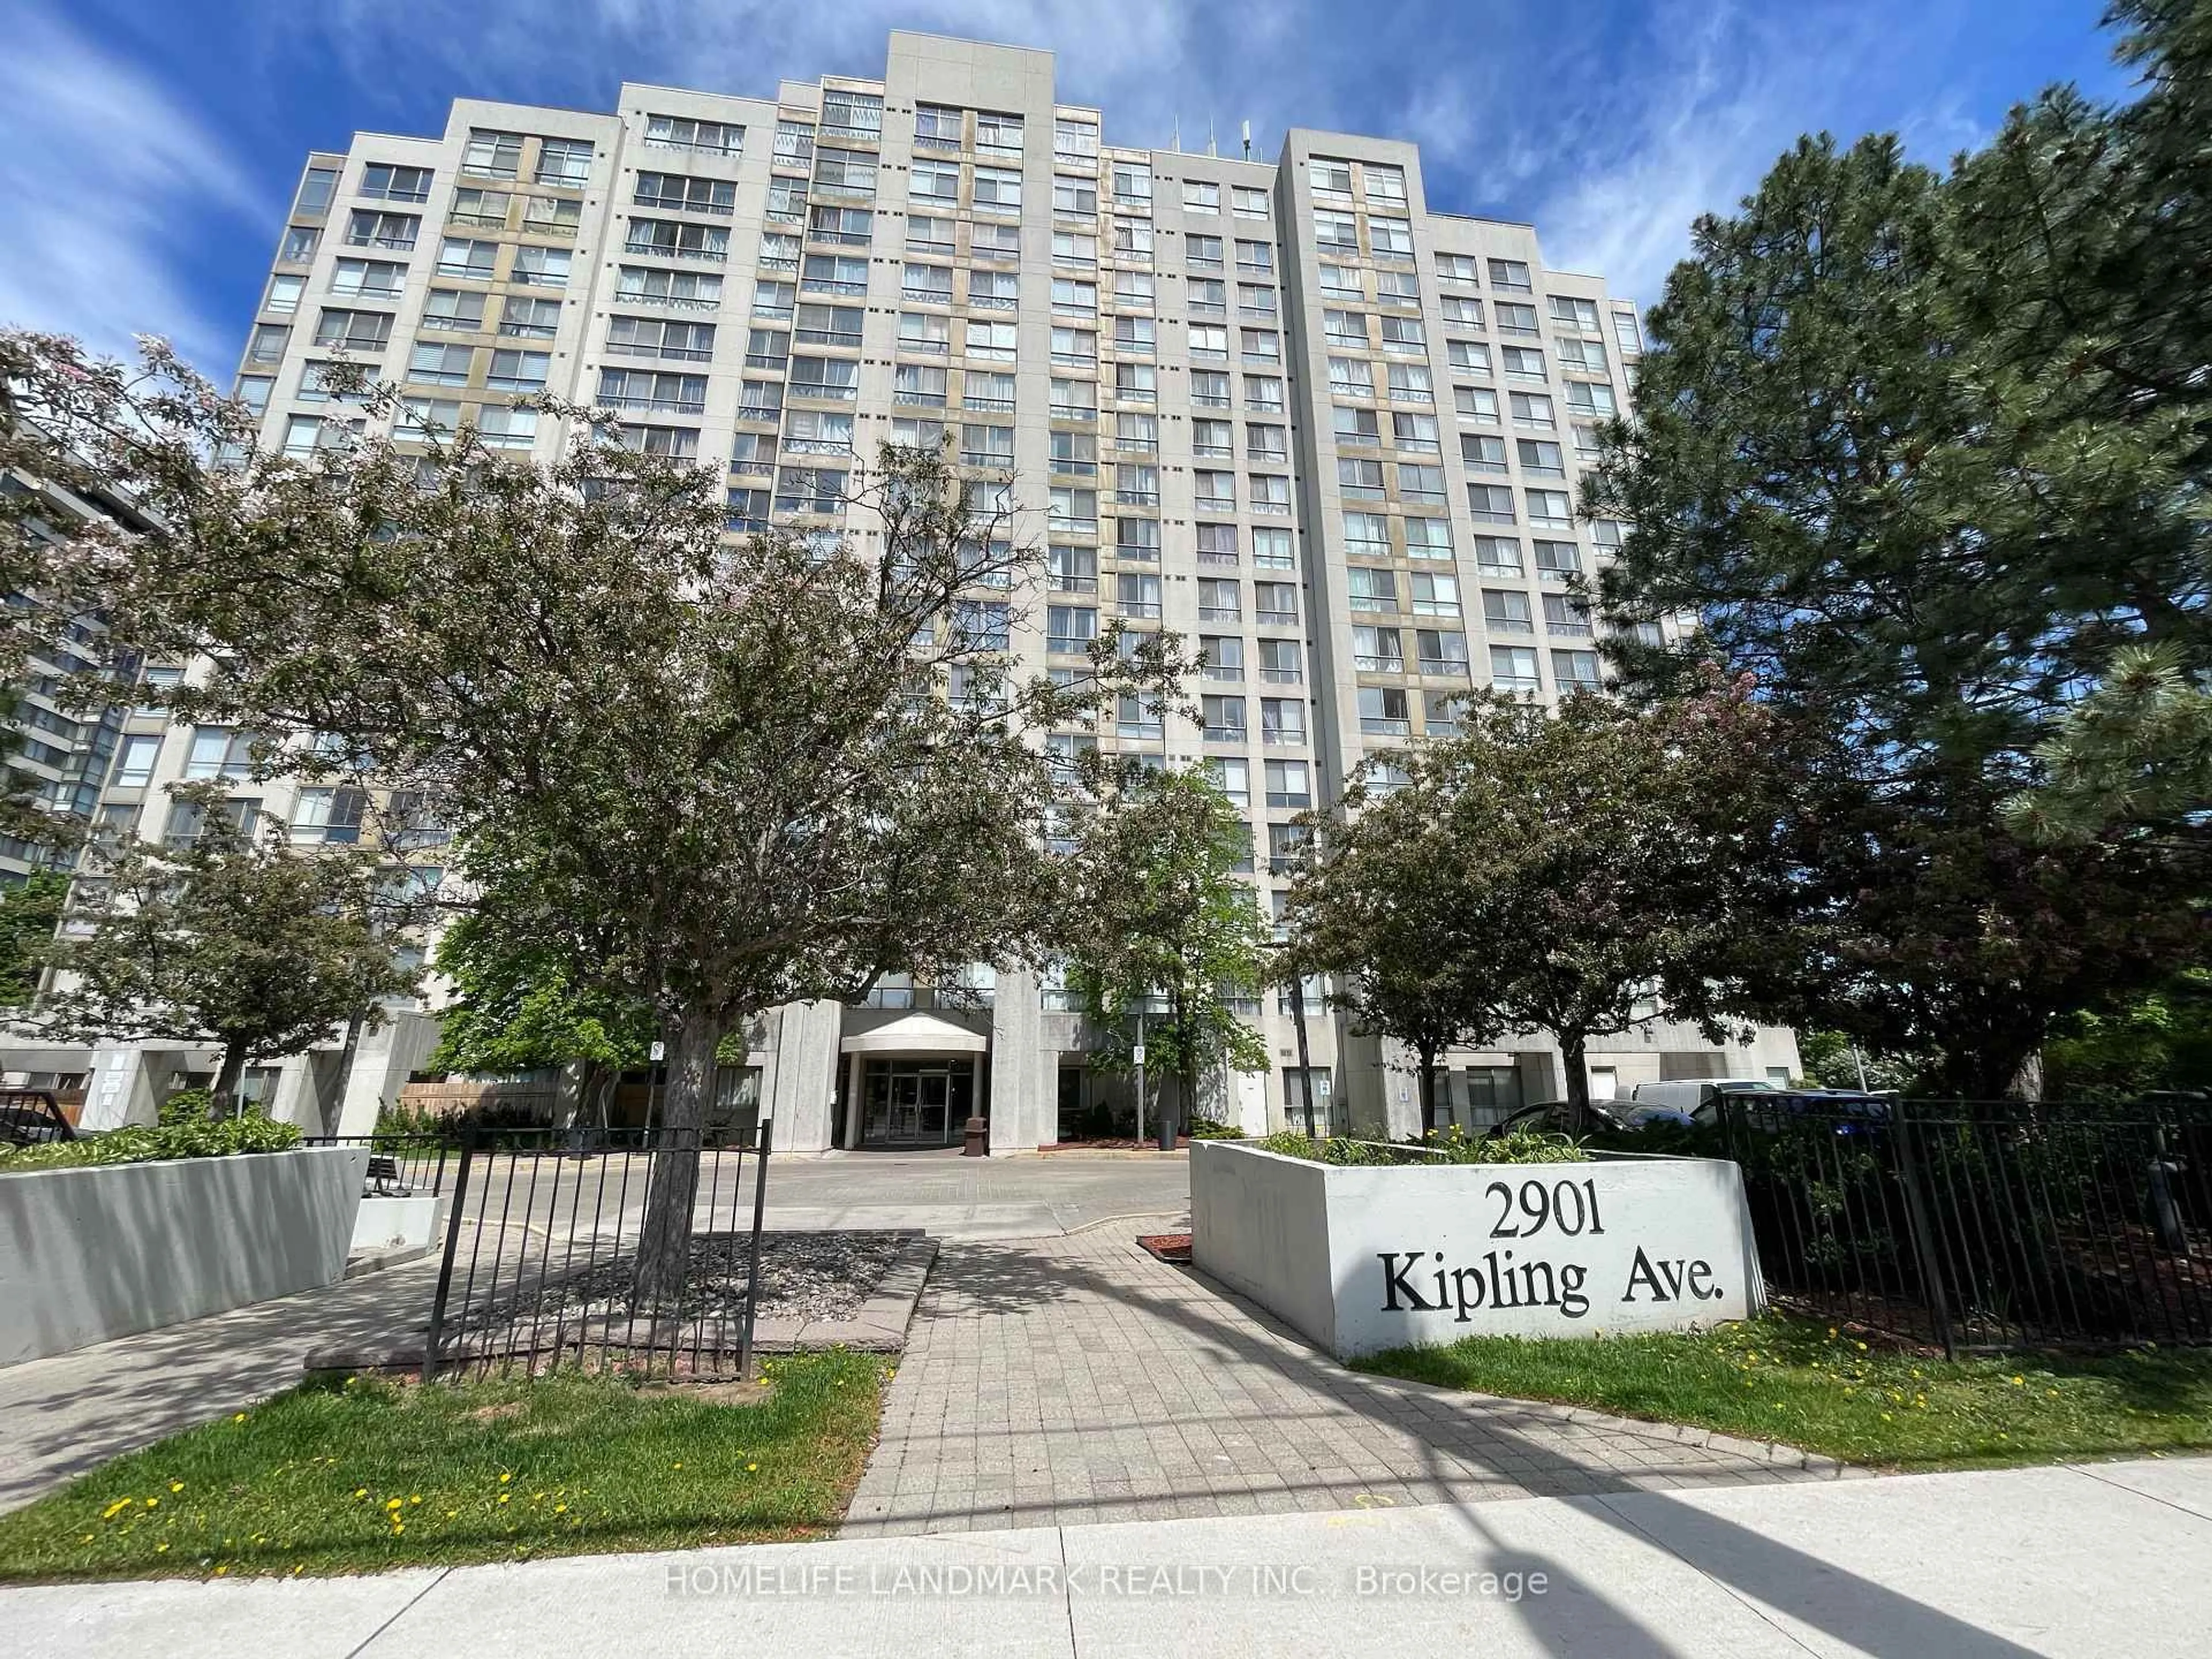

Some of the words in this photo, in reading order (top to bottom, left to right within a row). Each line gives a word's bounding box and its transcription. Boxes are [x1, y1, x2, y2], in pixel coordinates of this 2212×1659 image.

[1486, 1178, 1605, 1238] 2901
[1377, 1249, 1590, 1323] Kipling
[1622, 1245, 1724, 1302] Ave.
